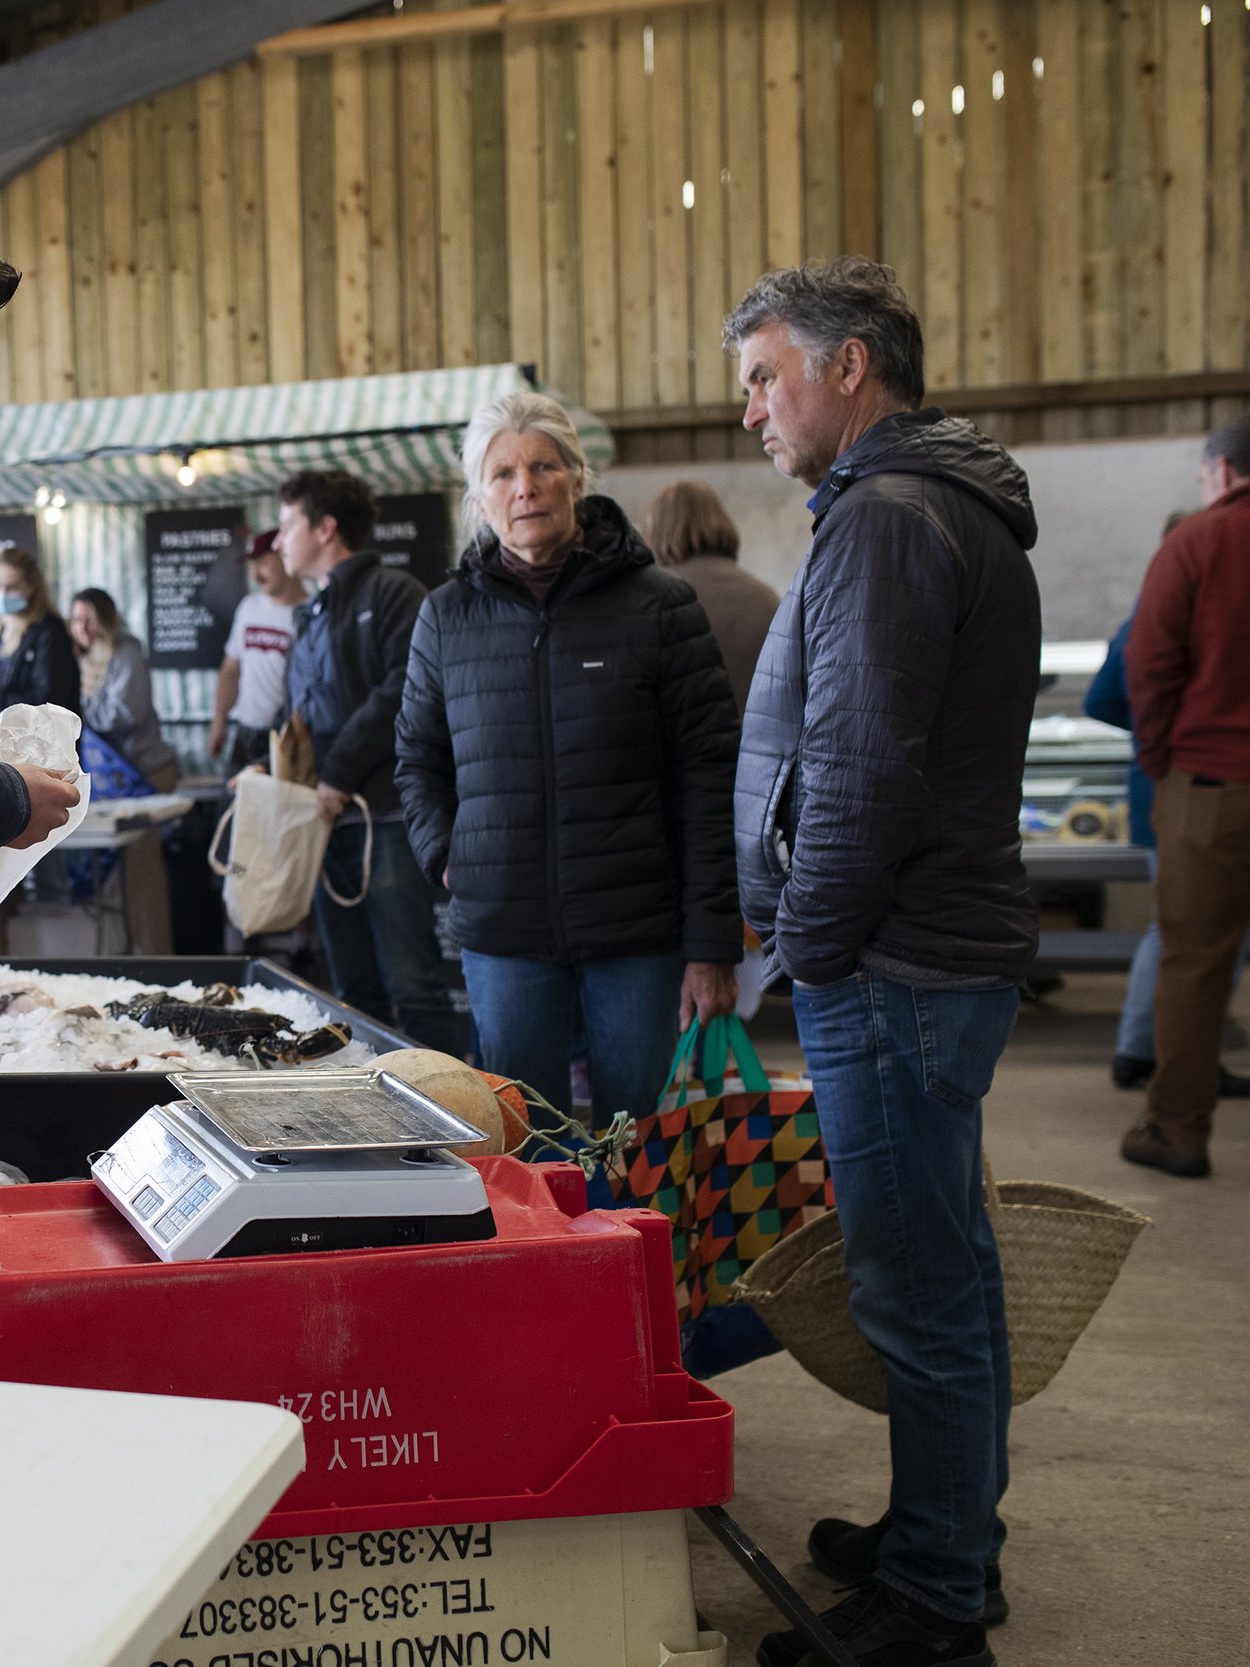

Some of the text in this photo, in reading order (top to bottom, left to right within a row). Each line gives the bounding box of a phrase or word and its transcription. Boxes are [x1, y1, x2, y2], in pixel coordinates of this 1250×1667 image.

[160, 528, 232, 549] PASTRIES
[327, 1430, 439, 1471] LIKELY
[500, 1625, 551, 1663] NO
